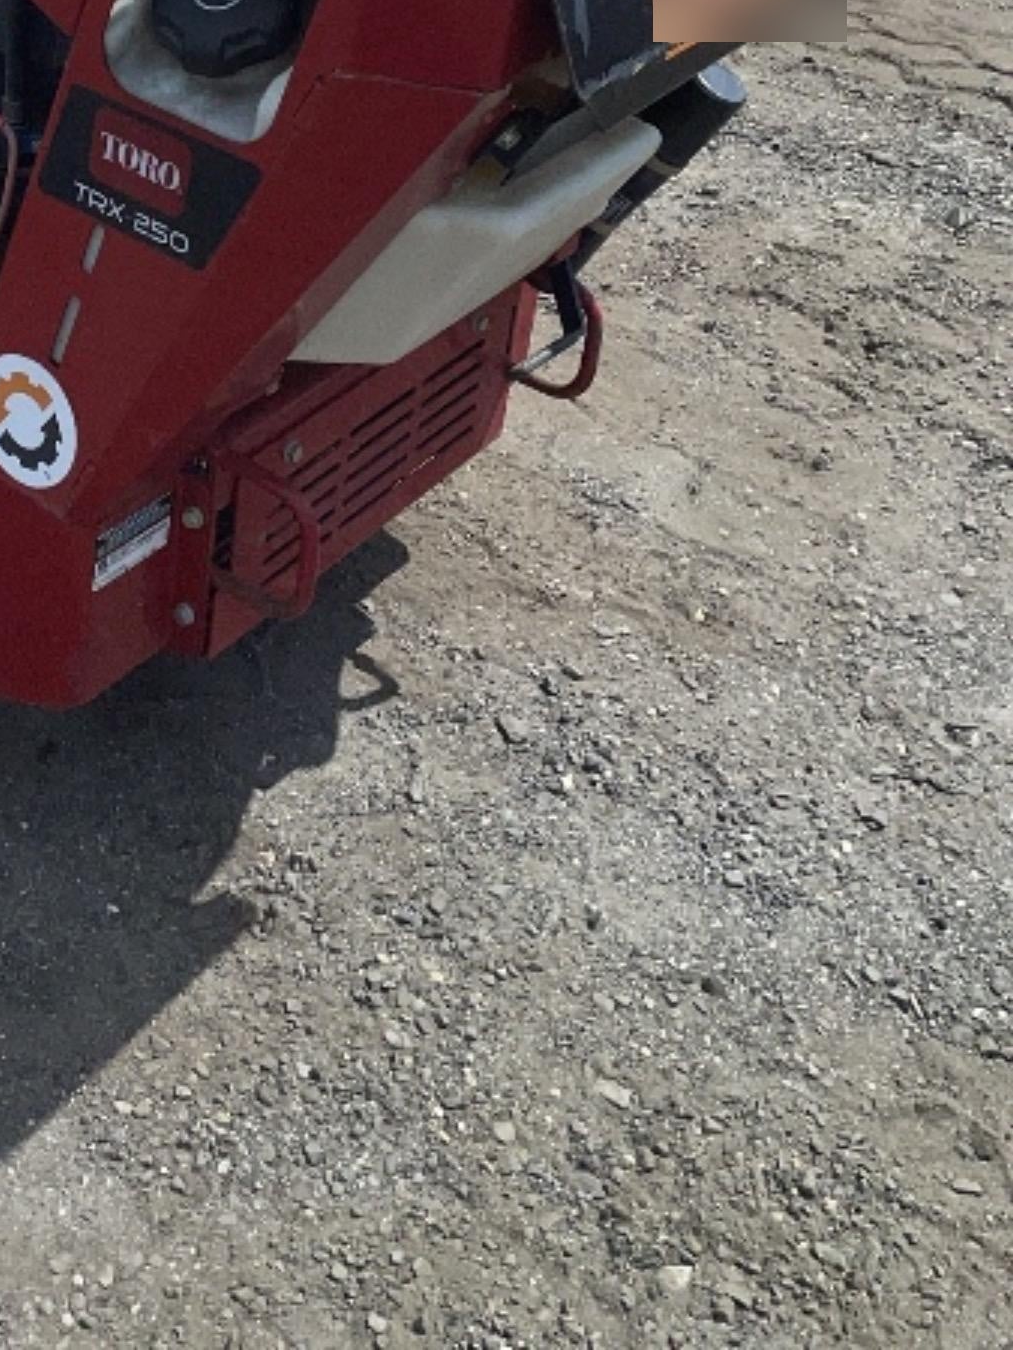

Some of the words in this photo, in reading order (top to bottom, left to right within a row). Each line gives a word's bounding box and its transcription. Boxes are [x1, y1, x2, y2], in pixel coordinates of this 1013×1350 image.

[101, 132, 181, 190] TORO
[74, 181, 124, 223] TRX
[133, 212, 189, 253] 250
